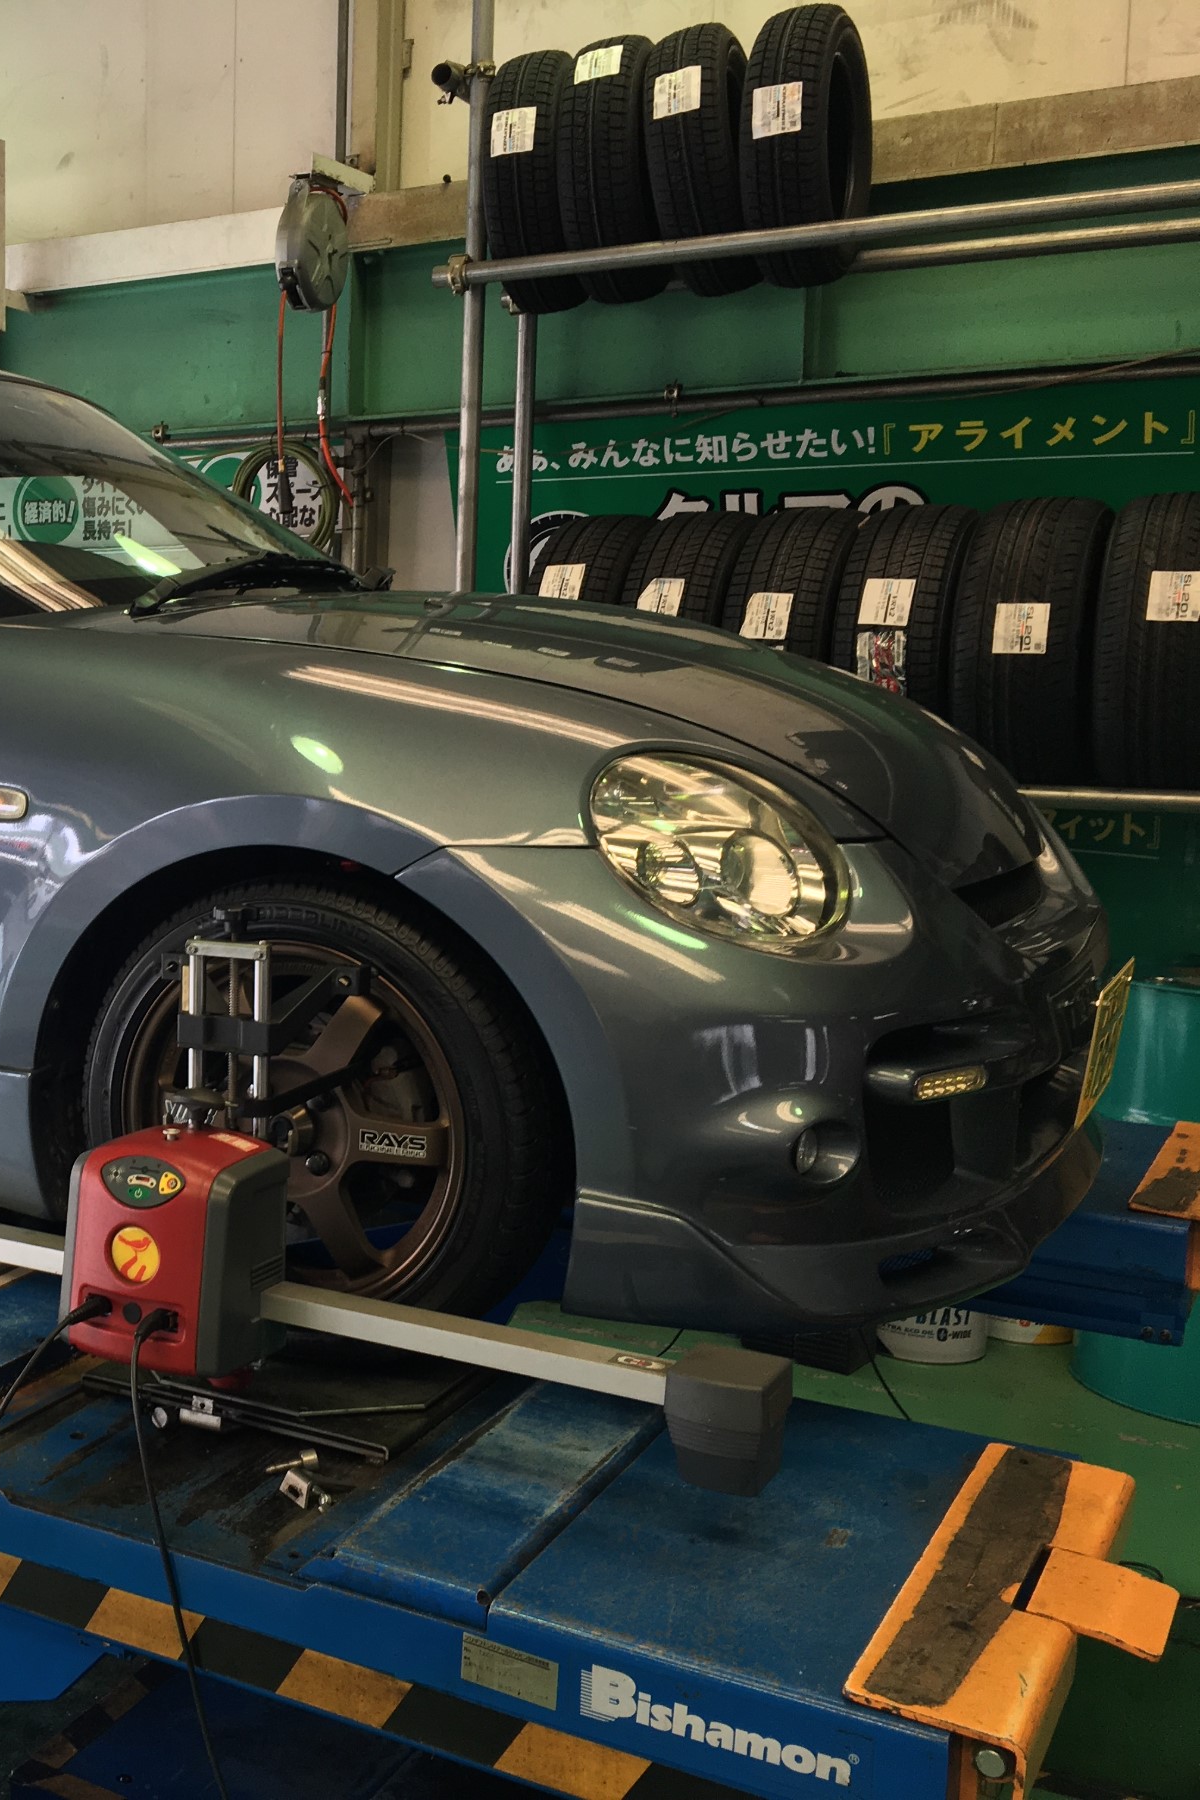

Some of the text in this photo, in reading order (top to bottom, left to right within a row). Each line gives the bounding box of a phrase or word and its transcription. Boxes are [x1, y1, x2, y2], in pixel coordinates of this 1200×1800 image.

[24, 500, 76, 525] 経済的!
[1181, 573, 1192, 619] SL201
[1023, 605, 1035, 651] SL201
[359, 1129, 427, 1152] RAYS
[580, 1664, 852, 1787] Bishamon
